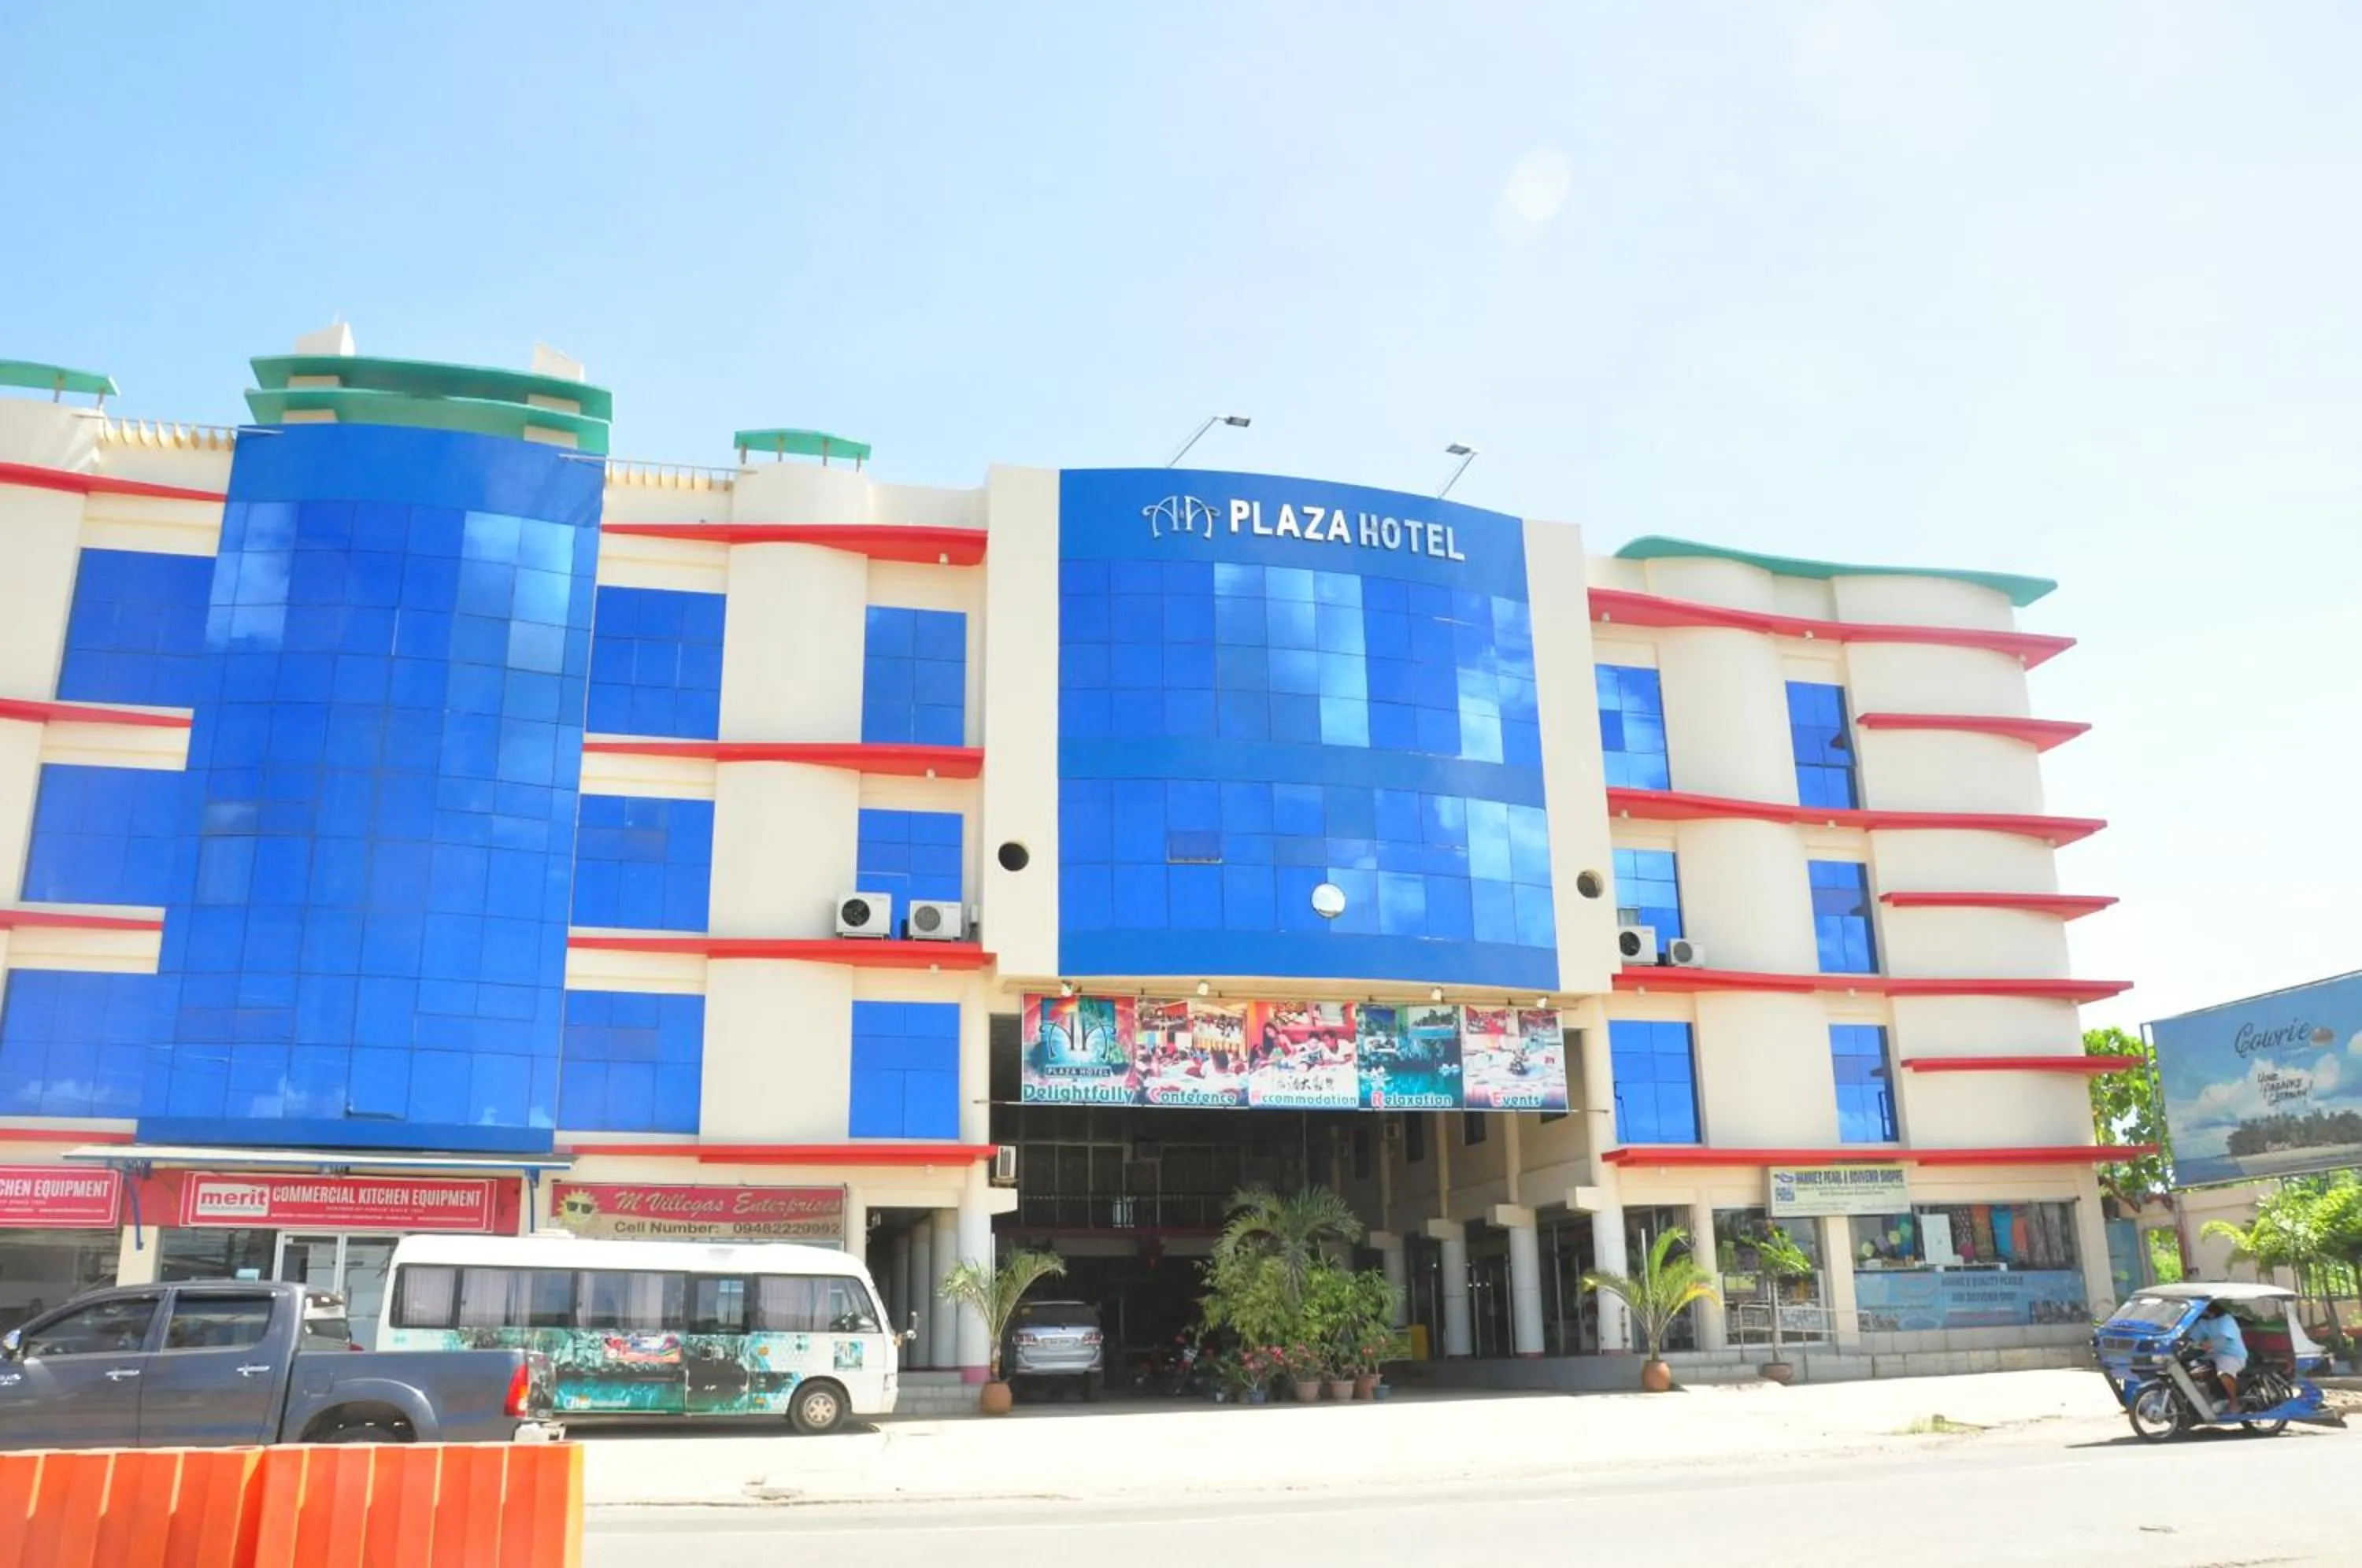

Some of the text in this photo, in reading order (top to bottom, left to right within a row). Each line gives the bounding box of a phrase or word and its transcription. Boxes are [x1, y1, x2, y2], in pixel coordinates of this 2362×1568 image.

[1230, 498, 1352, 543] PLAZA
[1360, 512, 1466, 562] HOTEL
[1023, 1083, 1134, 1103] Delightfully
[1150, 1086, 1236, 1104] Conference
[1372, 1091, 1453, 1108] Relaxation
[1492, 1091, 1541, 1107] Events
[34, 1180, 109, 1198] EQUIPMENT
[201, 1189, 267, 1206] merit
[272, 1185, 482, 1207] COMMERCIAL KITCHEN EQUIPMENT
[646, 1192, 724, 1218] Villegas
[615, 1221, 645, 1234] Cell
[650, 1222, 719, 1235] Number:
